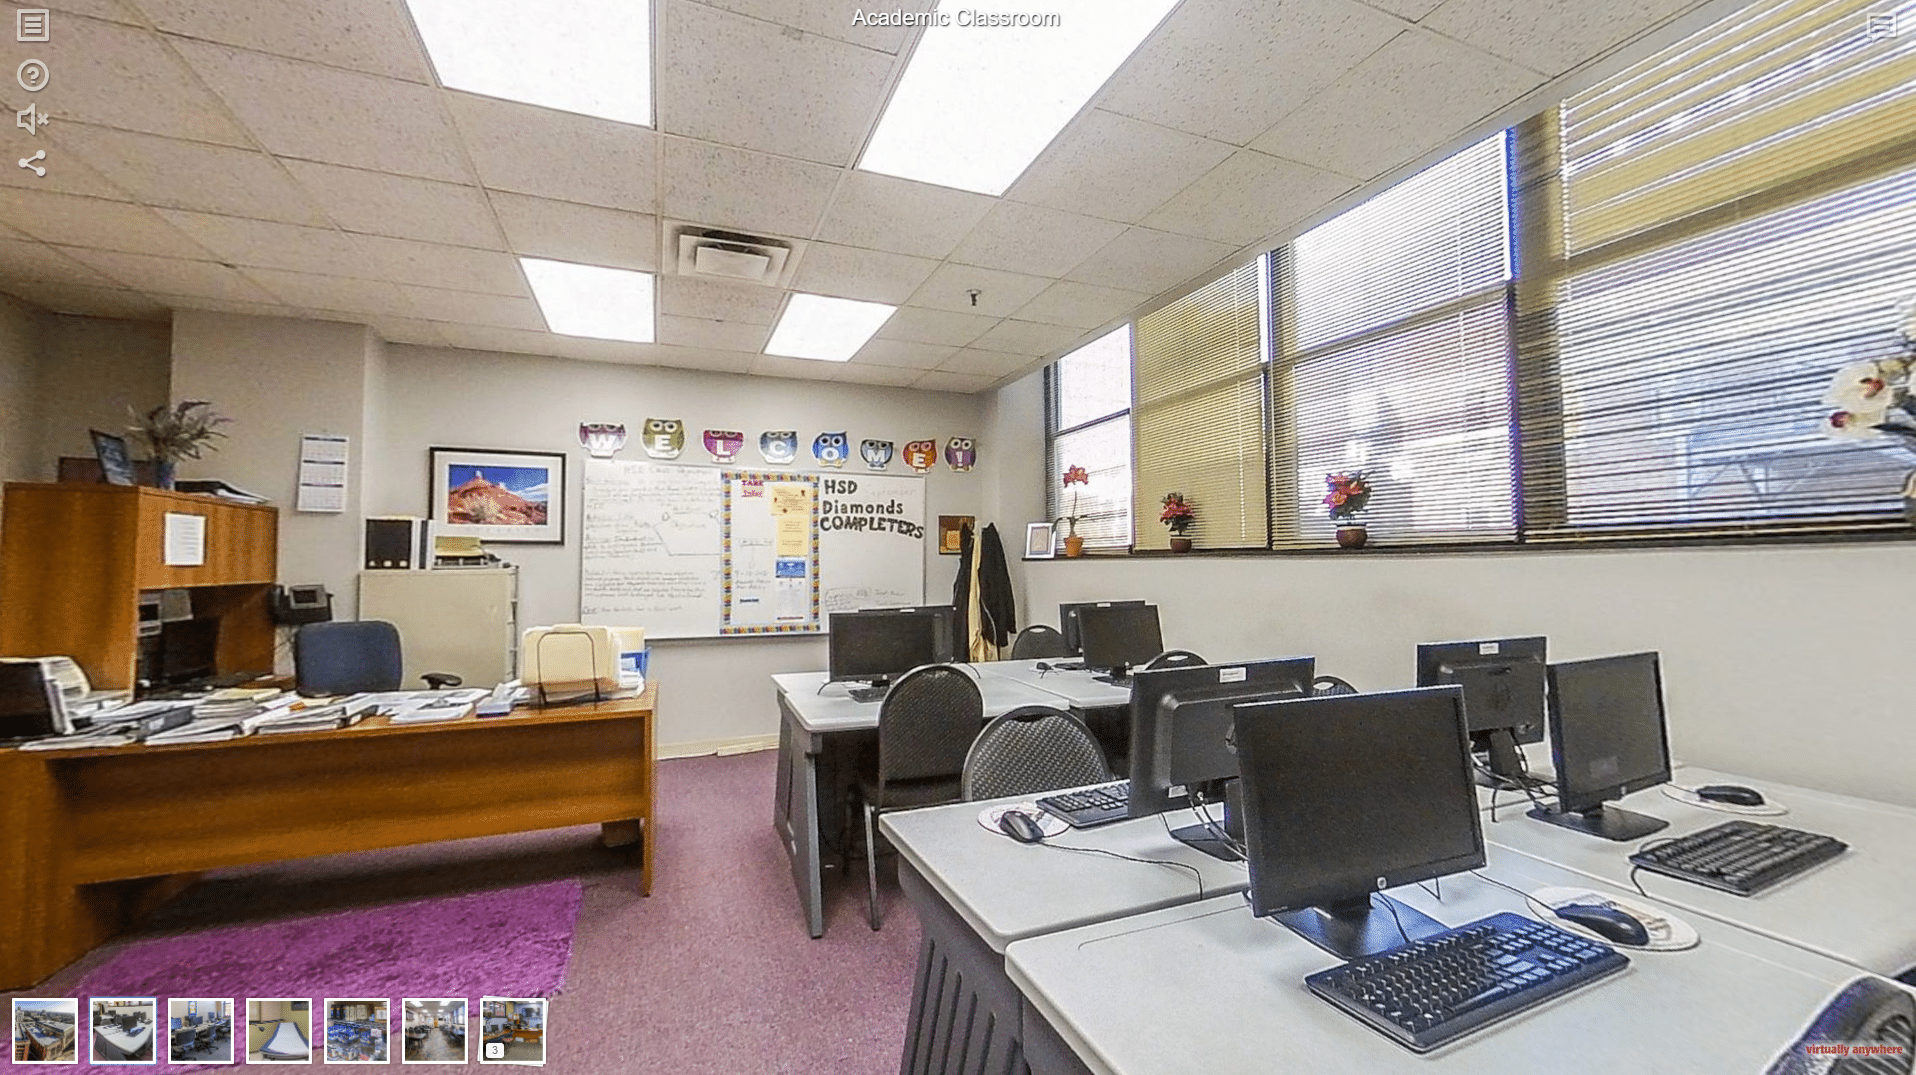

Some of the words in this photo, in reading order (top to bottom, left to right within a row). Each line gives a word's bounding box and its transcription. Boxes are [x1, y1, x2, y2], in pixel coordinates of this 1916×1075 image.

[824, 479, 858, 495] HSD
[822, 499, 904, 515] Diamonds
[820, 515, 925, 539] COMPLETERS
